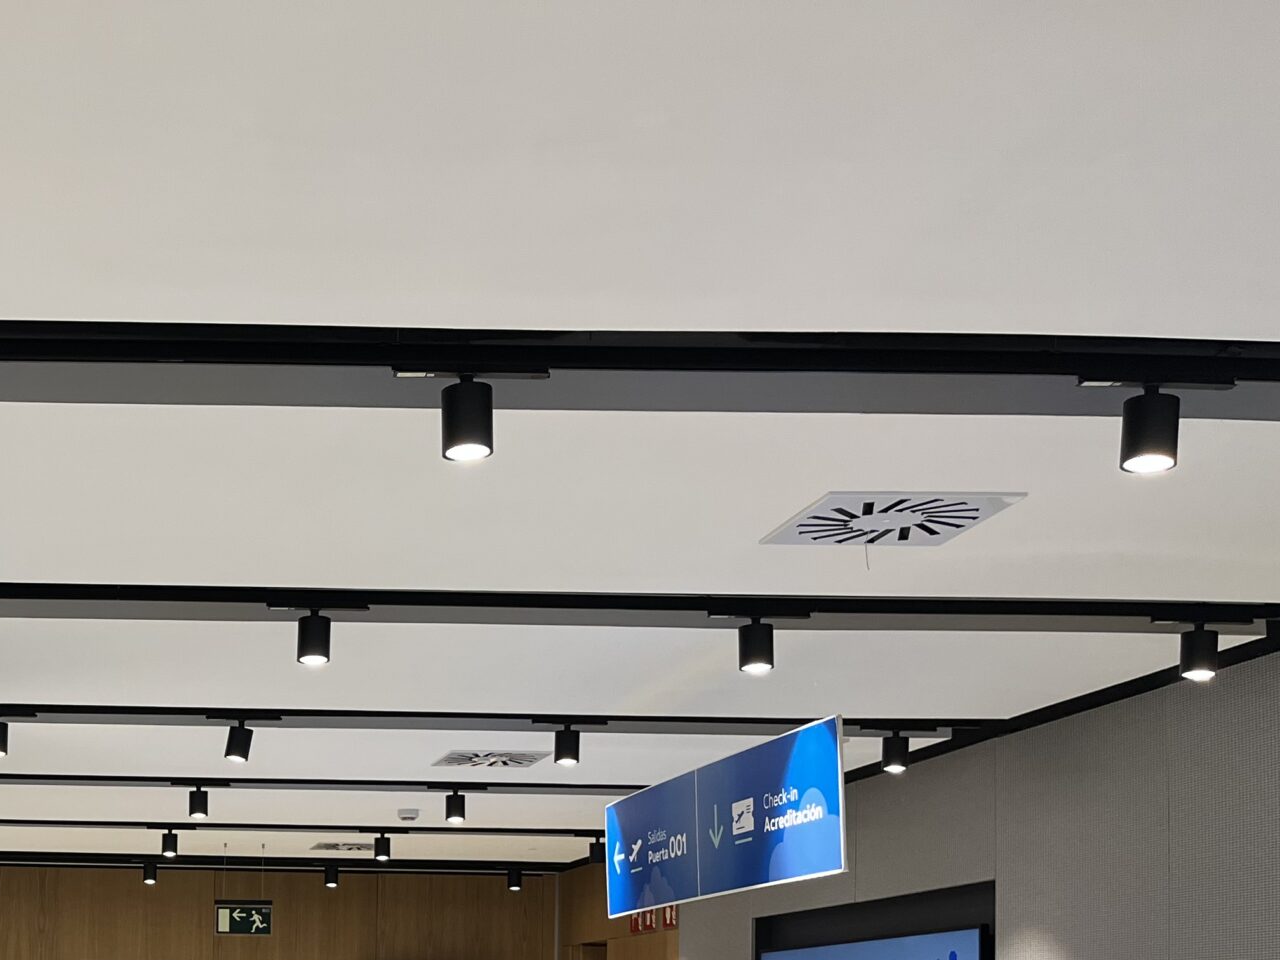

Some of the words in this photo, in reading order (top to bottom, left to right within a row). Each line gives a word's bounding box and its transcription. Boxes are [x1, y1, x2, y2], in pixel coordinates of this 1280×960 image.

[763, 787, 798, 809] Check-in
[764, 804, 823, 832] Acreditación
[648, 828, 667, 845] Salidas
[648, 848, 668, 864] Puerta
[669, 833, 687, 858] 001
